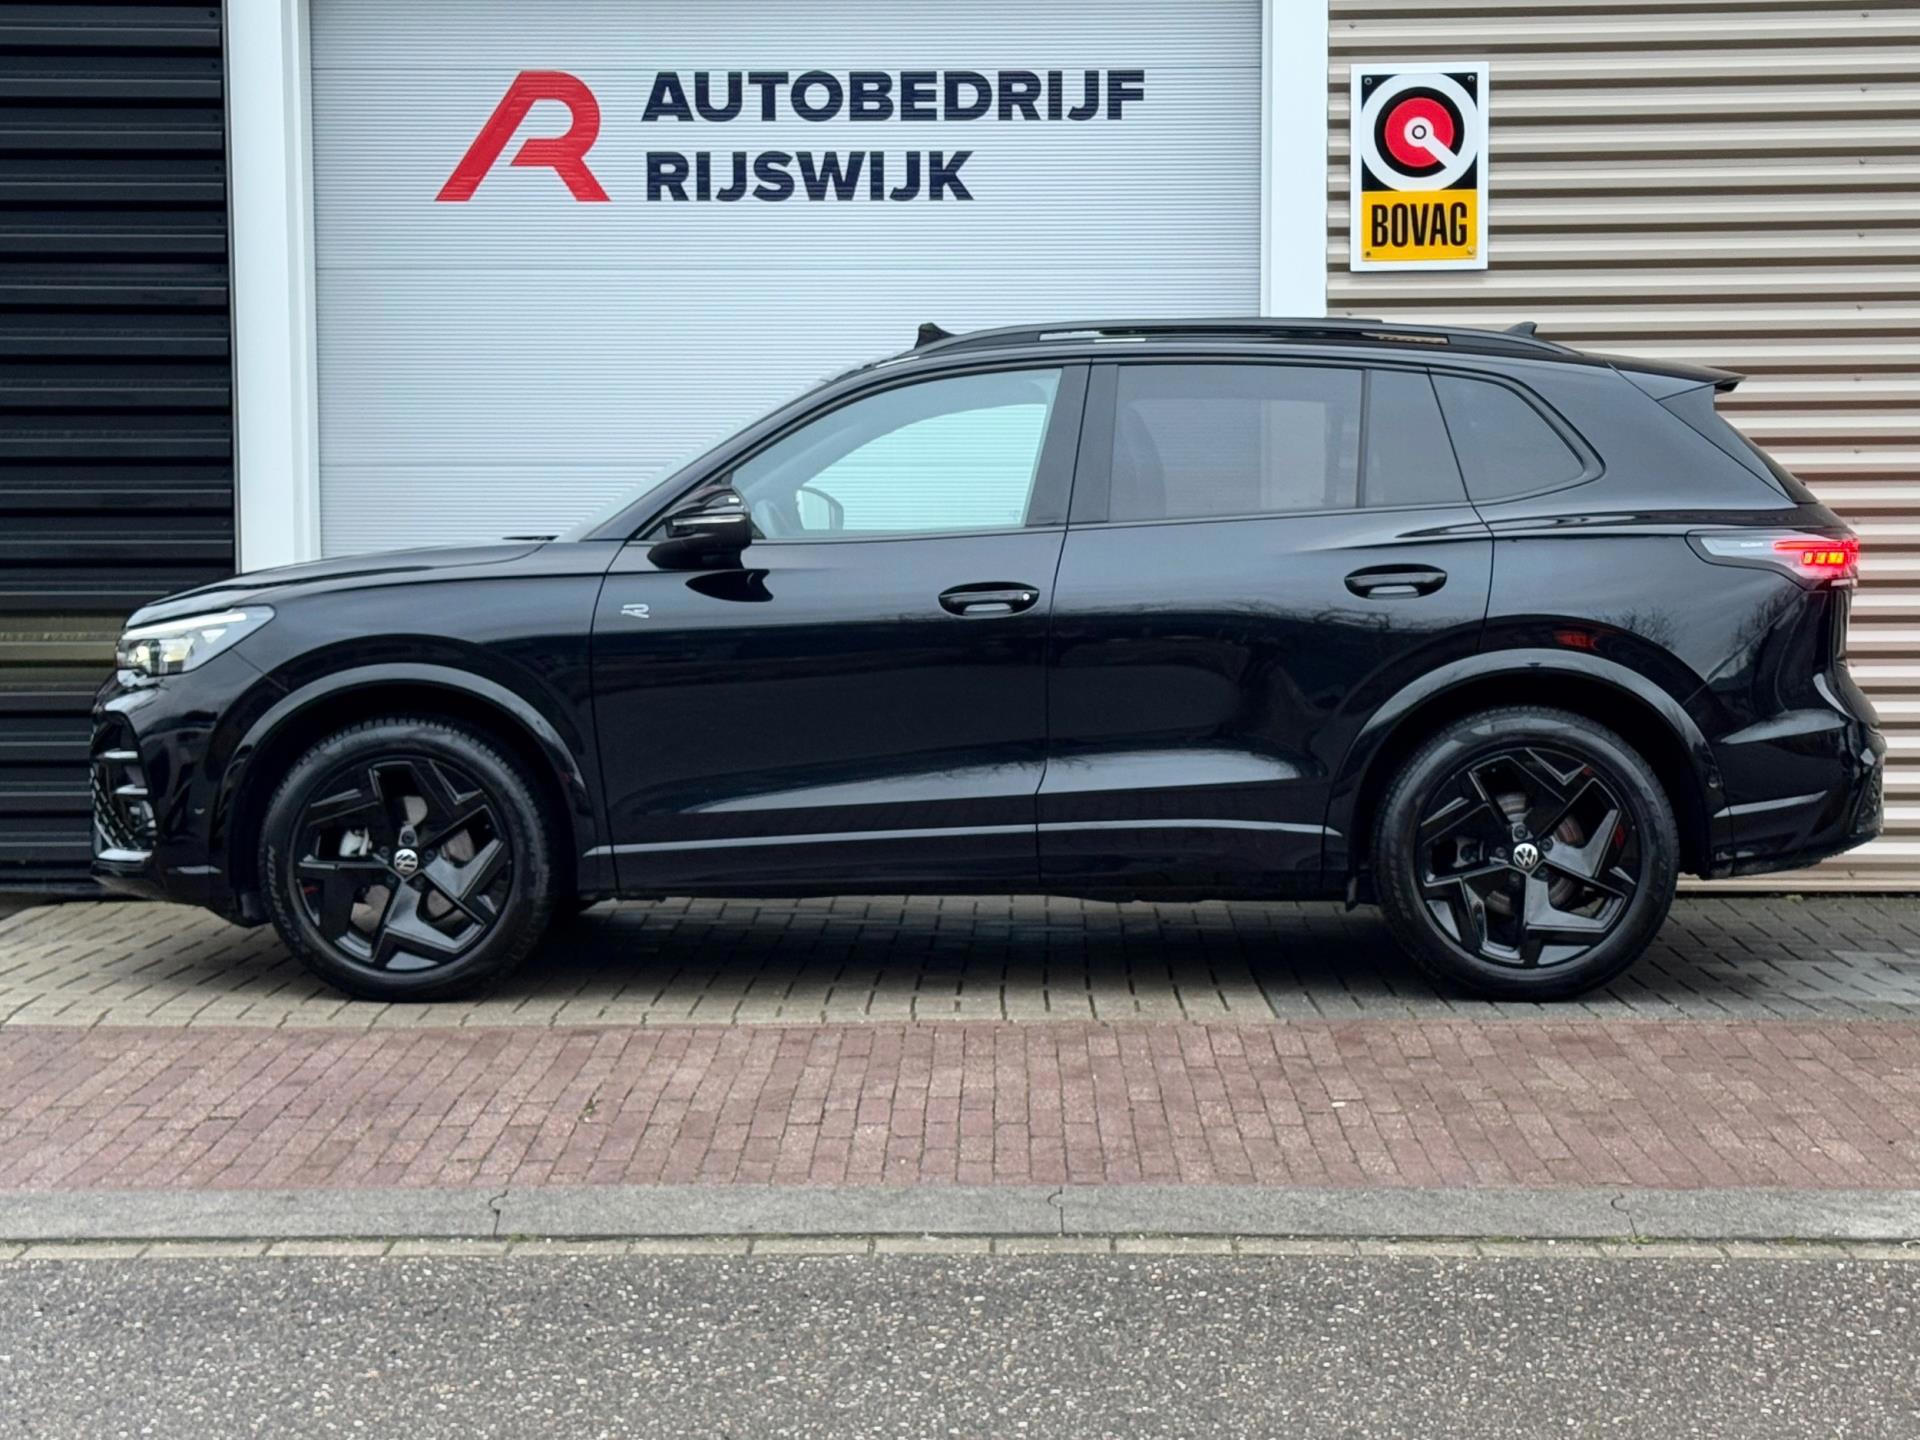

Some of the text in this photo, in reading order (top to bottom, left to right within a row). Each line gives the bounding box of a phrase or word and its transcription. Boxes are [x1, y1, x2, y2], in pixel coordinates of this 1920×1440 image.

[641, 69, 1145, 122] AUTOBEDRIJF
[646, 150, 974, 202] RIJSWIJK
[1371, 202, 1467, 247] BOVAG
[1513, 843, 1538, 869] VW
